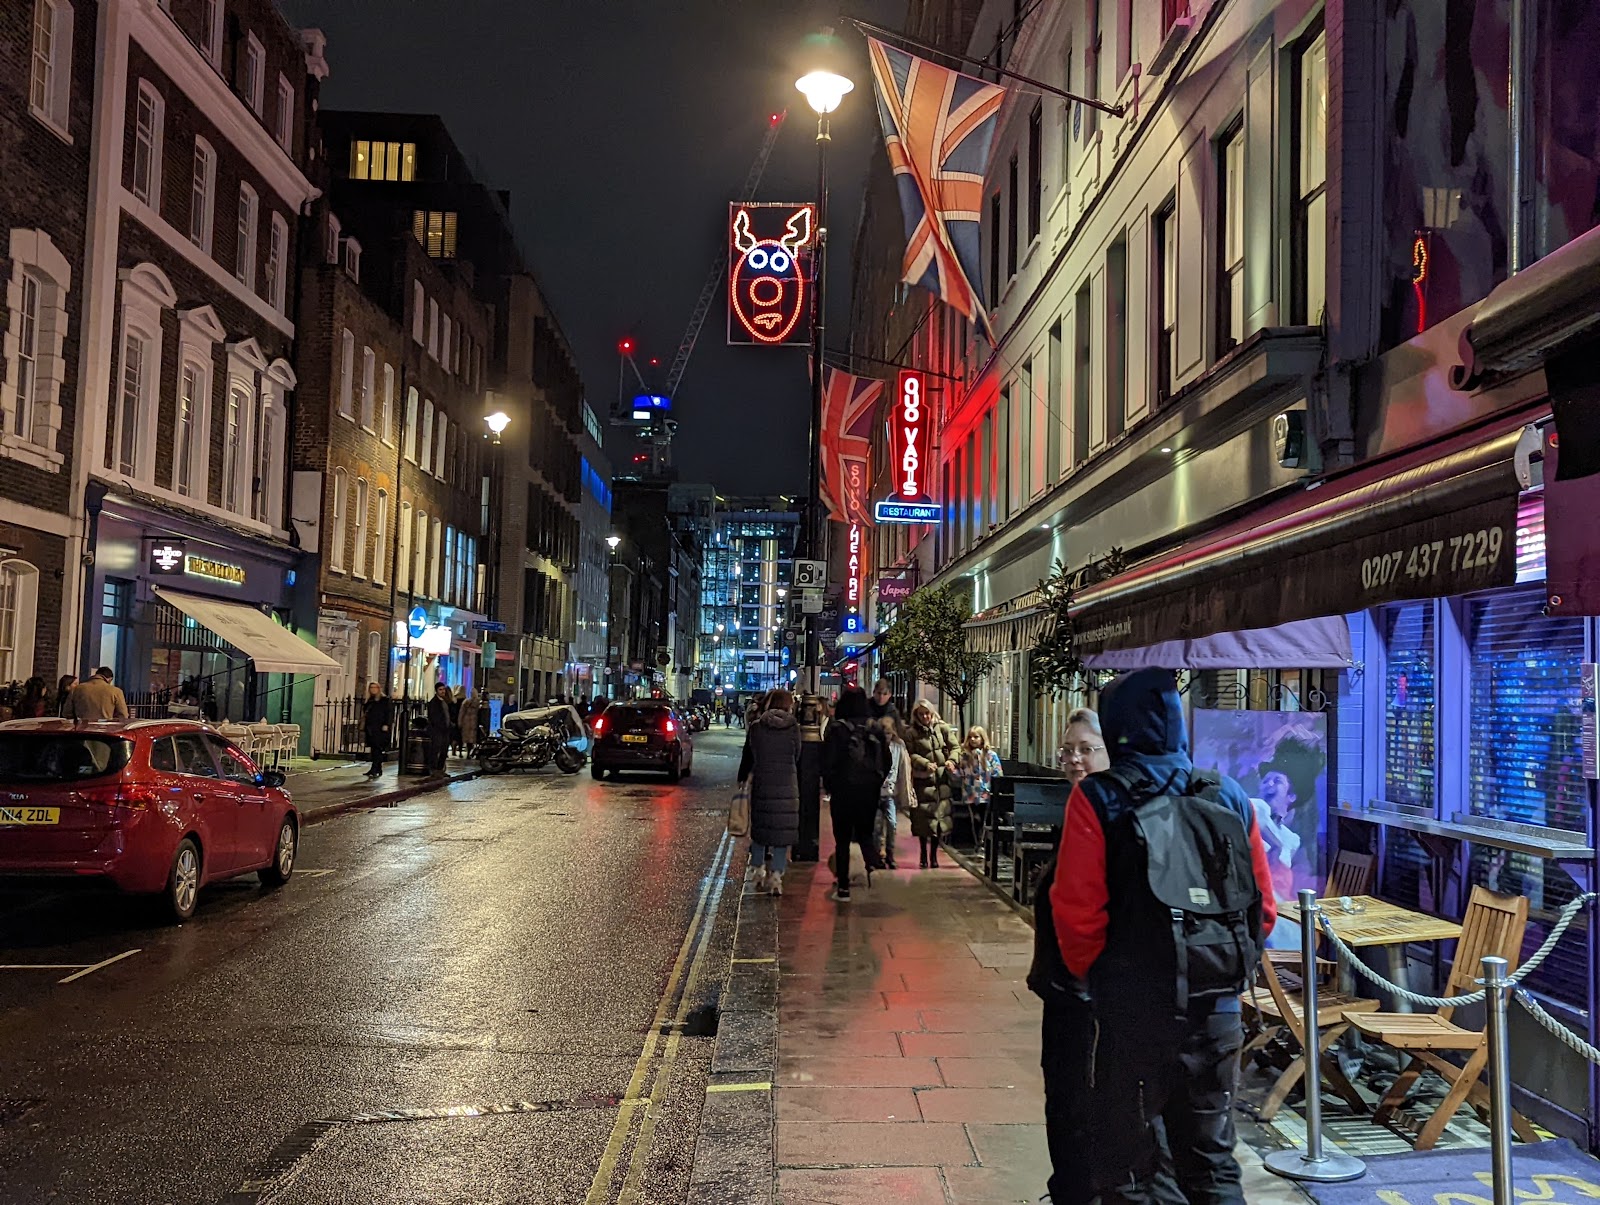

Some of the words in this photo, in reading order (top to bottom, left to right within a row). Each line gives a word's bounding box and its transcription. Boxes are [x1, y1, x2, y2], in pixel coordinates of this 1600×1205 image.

[904, 378, 920, 422] QUO
[903, 427, 919, 496] VADIS
[883, 507, 936, 518] RESTAURANT
[849, 519, 859, 600] THEATRE
[1361, 550, 1404, 590] 0207
[1405, 540, 1444, 579] 437
[1450, 526, 1503, 573] 7229
[881, 584, 910, 598] Japes
[0, 809, 22, 821] N14
[27, 809, 53, 822] ZDL
